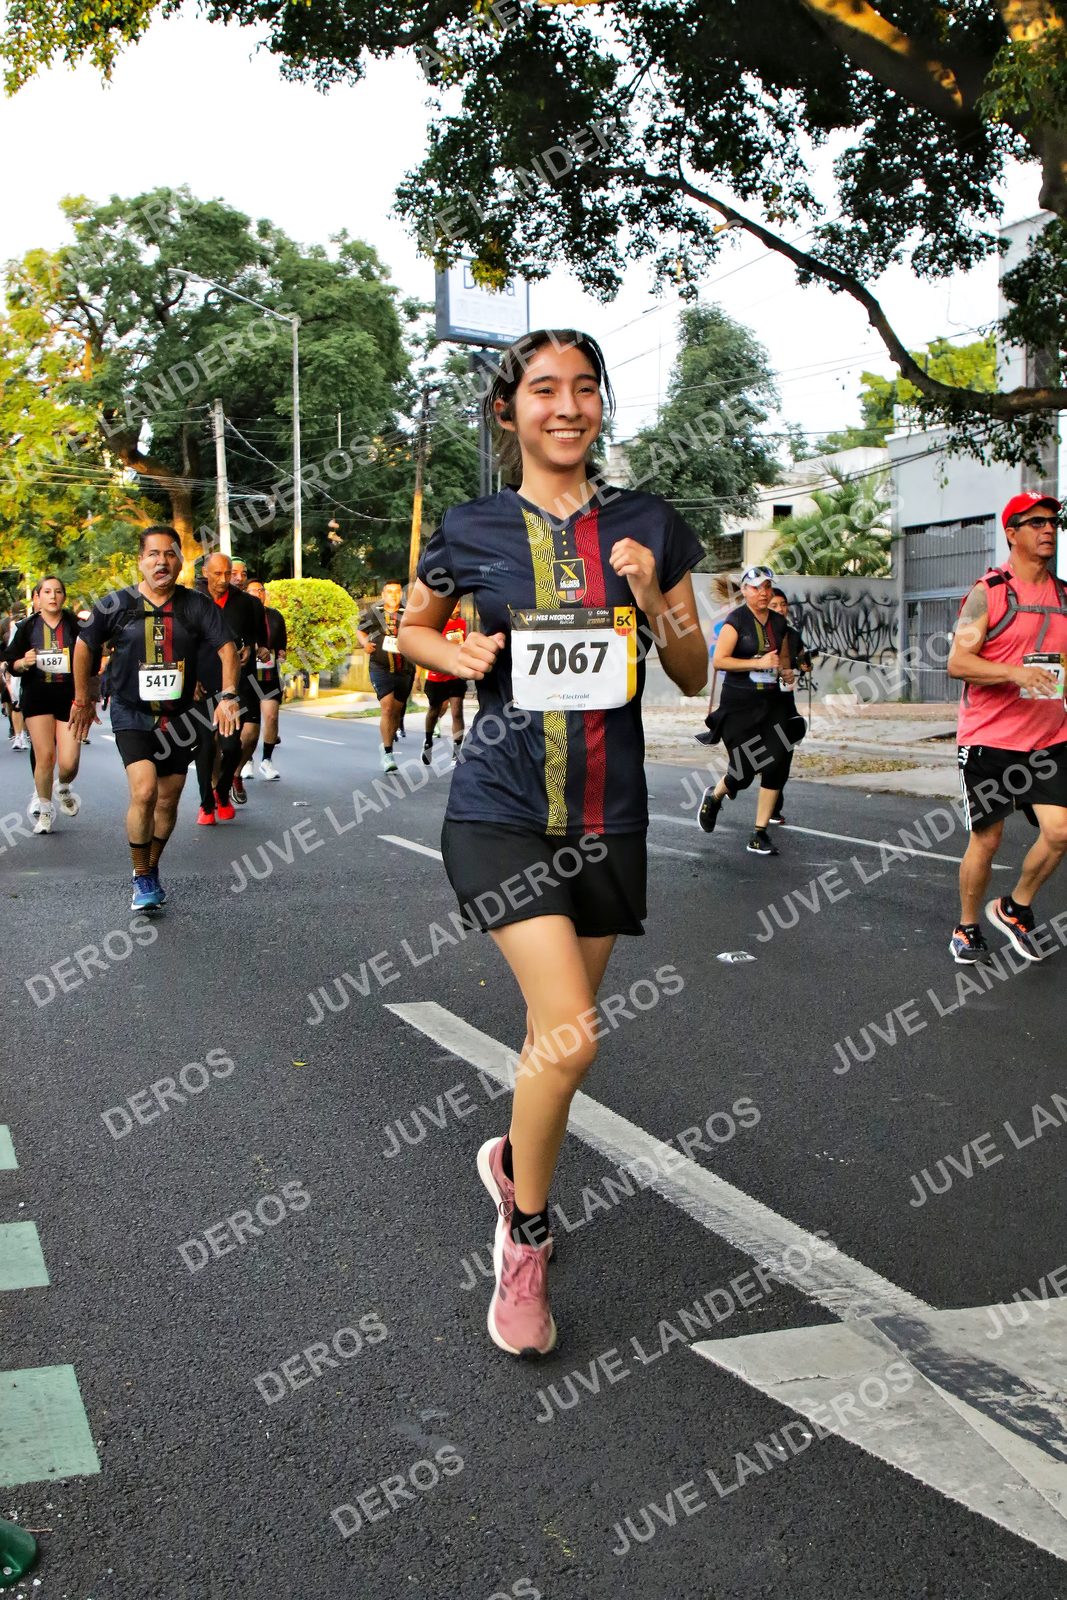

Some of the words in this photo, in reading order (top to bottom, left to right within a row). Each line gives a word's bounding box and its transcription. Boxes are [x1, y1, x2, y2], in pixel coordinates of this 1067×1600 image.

[525, 613, 549, 621] LENES
[616, 615, 631, 626] 5K
[41, 657, 62, 666] 1587
[526, 641, 609, 675] 7067
[146, 674, 176, 688] 5417
